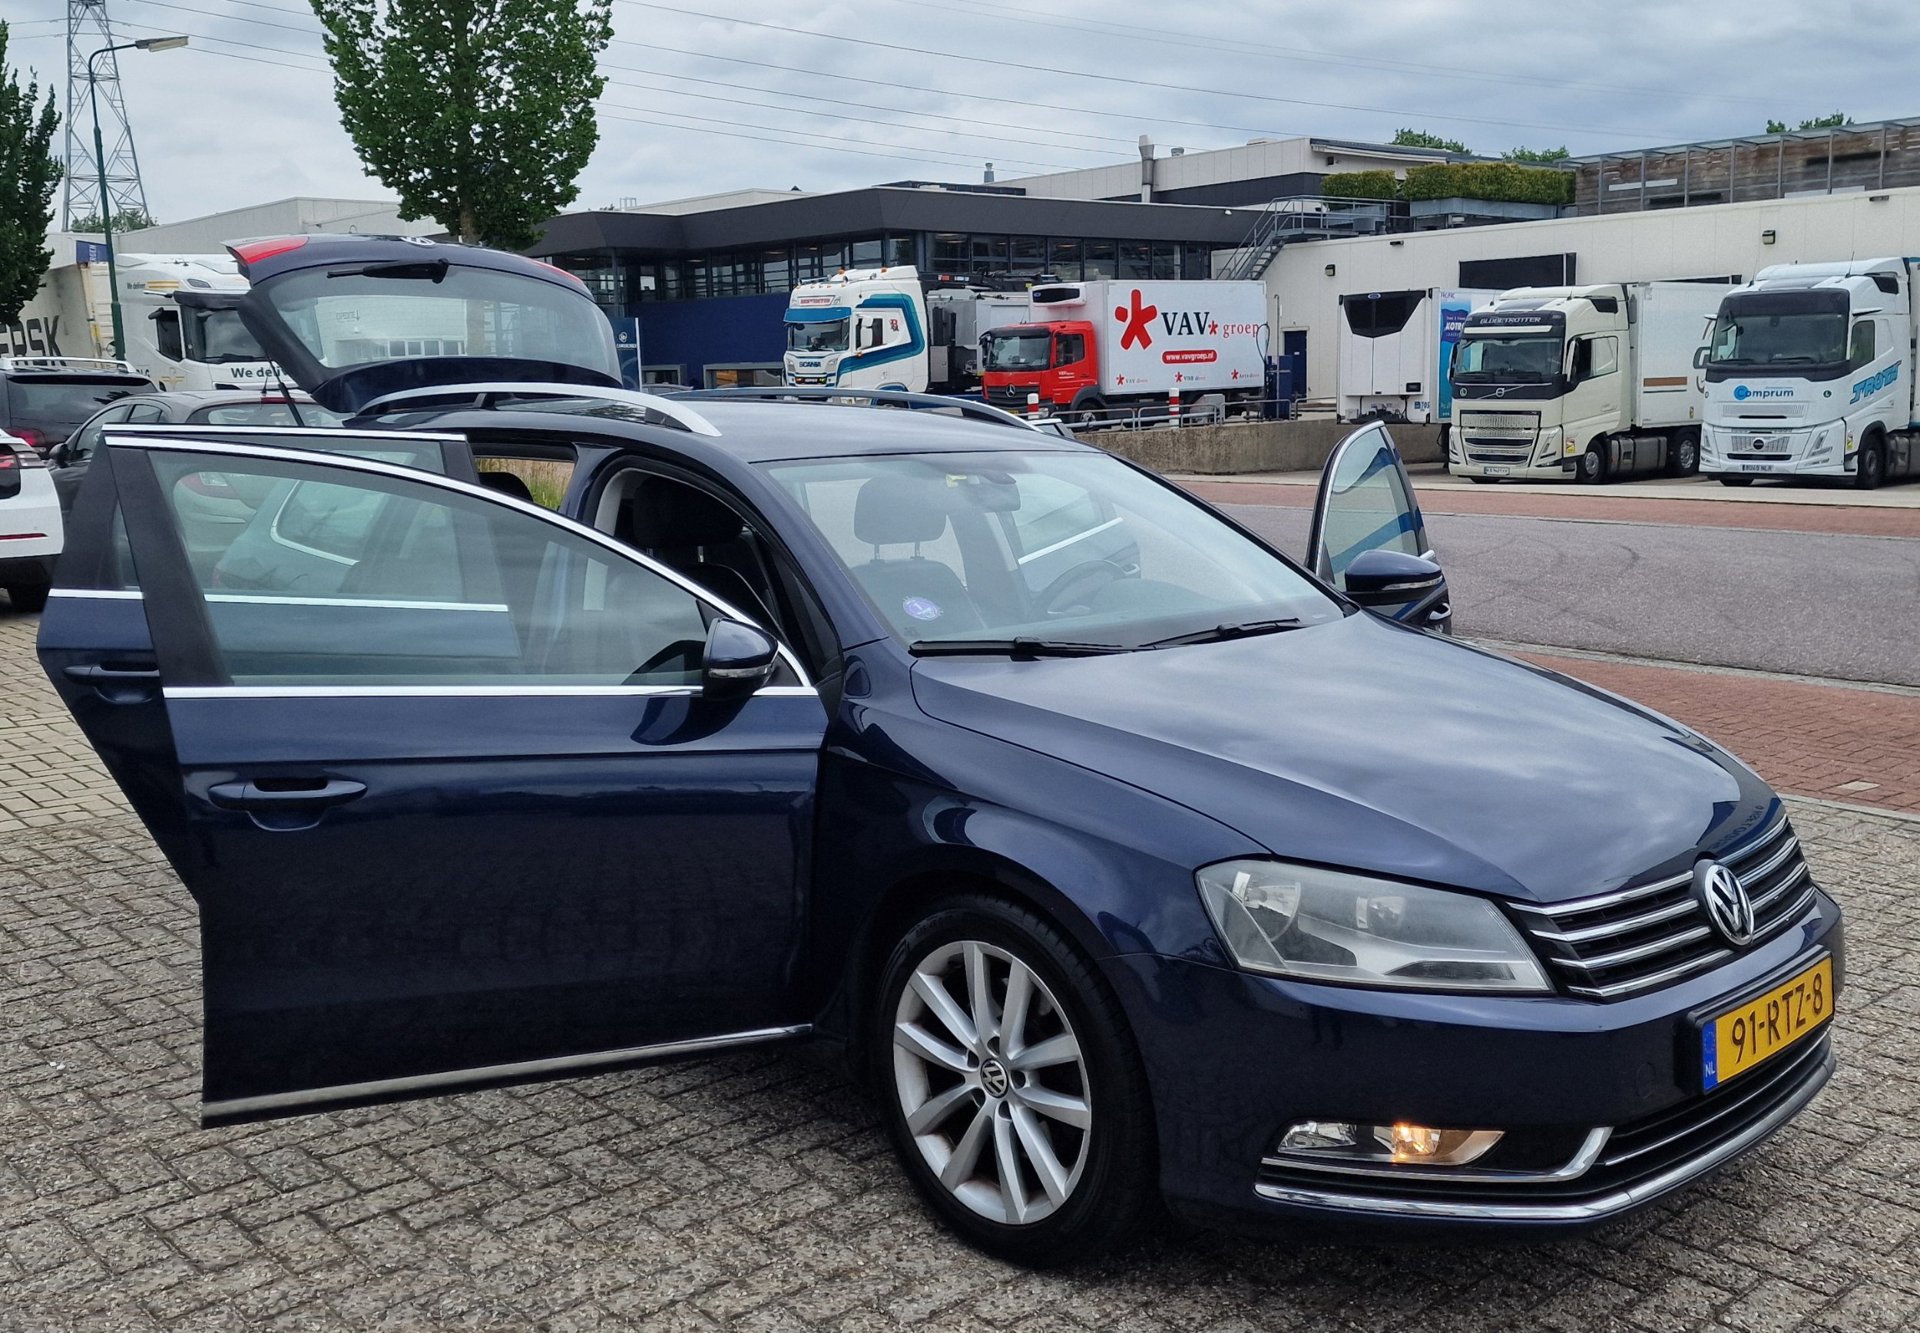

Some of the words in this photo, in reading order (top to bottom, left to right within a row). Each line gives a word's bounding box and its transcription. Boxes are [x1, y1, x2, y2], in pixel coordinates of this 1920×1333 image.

[1161, 311, 1210, 336] VAV
[1223, 323, 1259, 338] groep
[1165, 352, 1215, 361] www.vavgroep.nl
[231, 367, 252, 378] We
[1734, 385, 1794, 400] Comprum
[1731, 973, 1824, 1064] 91-RTZ-8
[1704, 1063, 1716, 1075] NL
